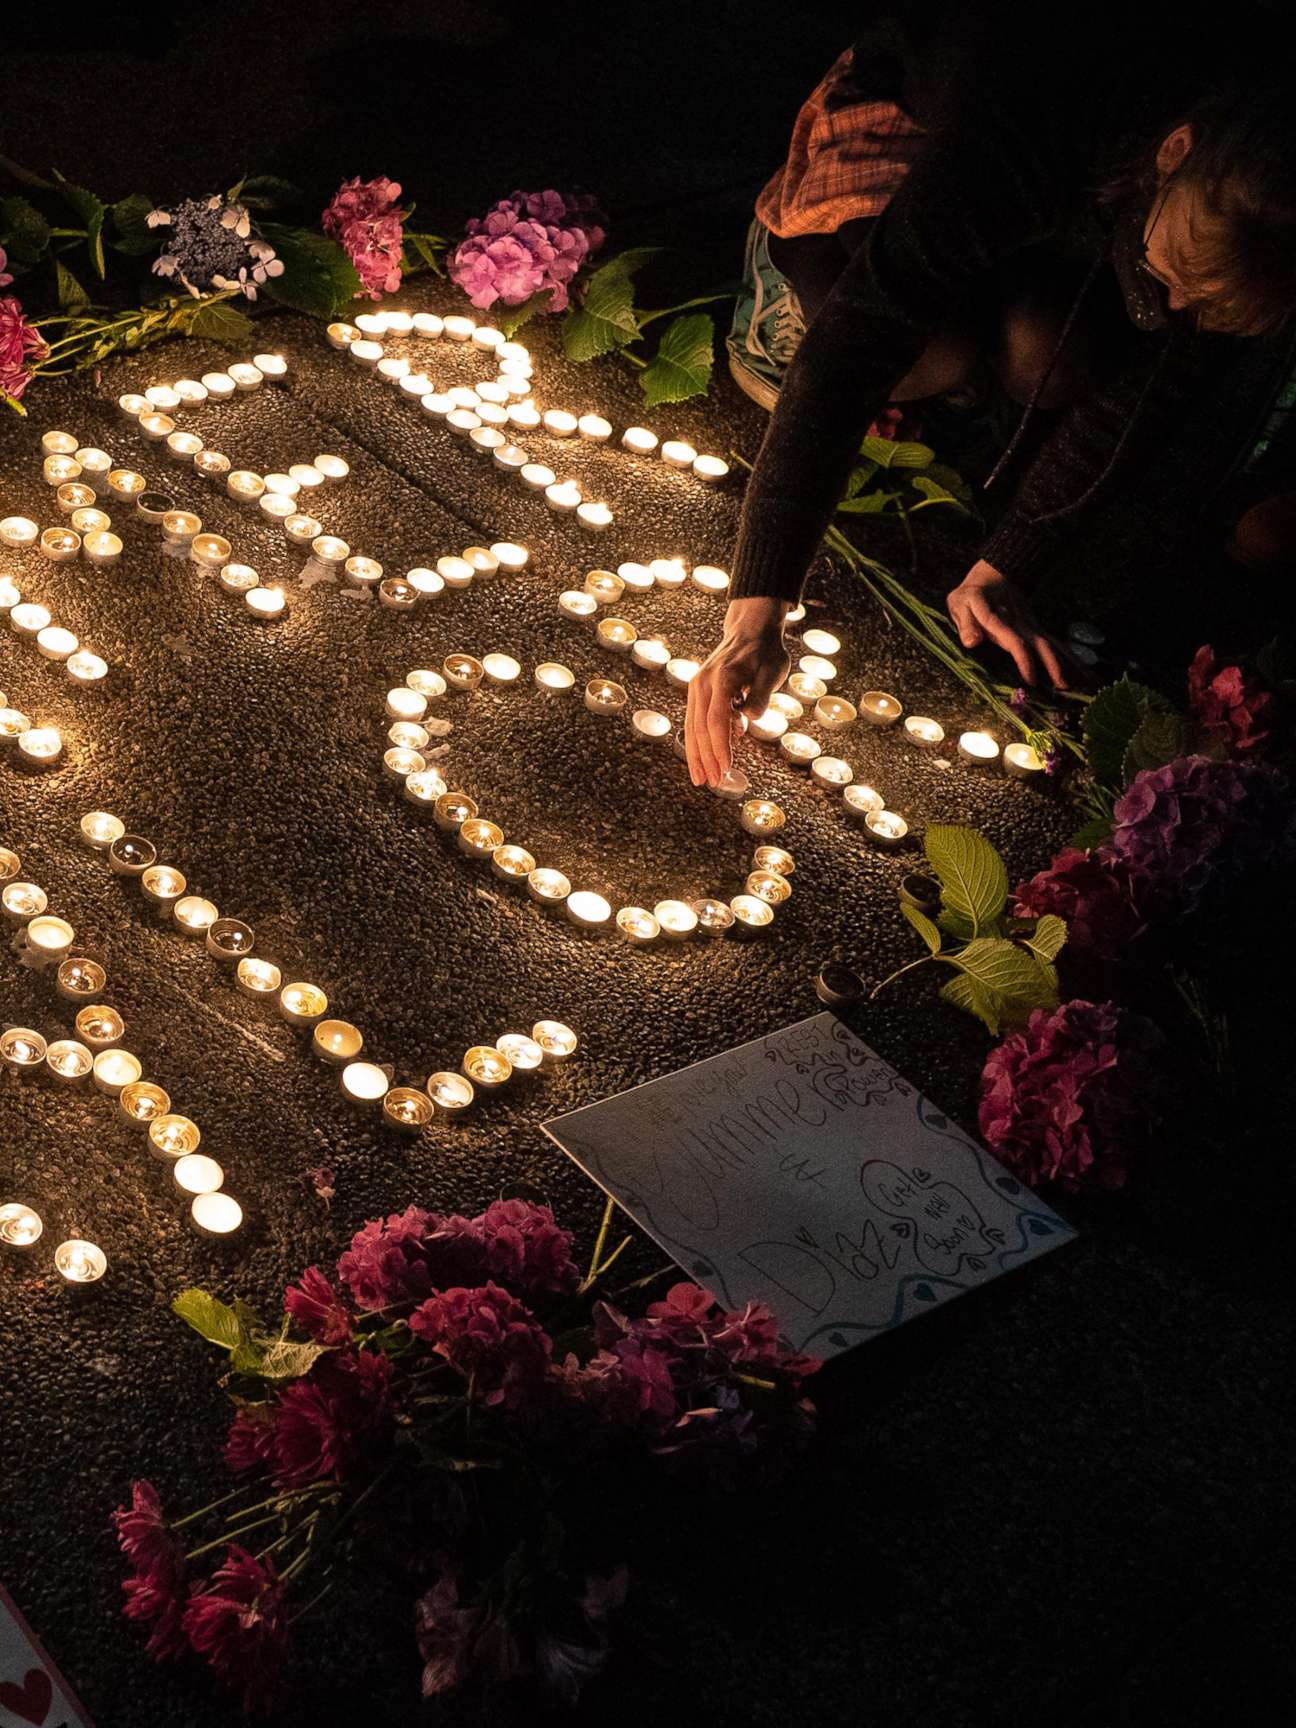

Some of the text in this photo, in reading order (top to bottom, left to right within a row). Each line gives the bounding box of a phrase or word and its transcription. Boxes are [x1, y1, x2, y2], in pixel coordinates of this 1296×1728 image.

[778, 1023, 831, 1058] REST
[631, 1068, 845, 1231] Summer
[877, 1178, 919, 1208] Get
[737, 1218, 901, 1317] Diaz
